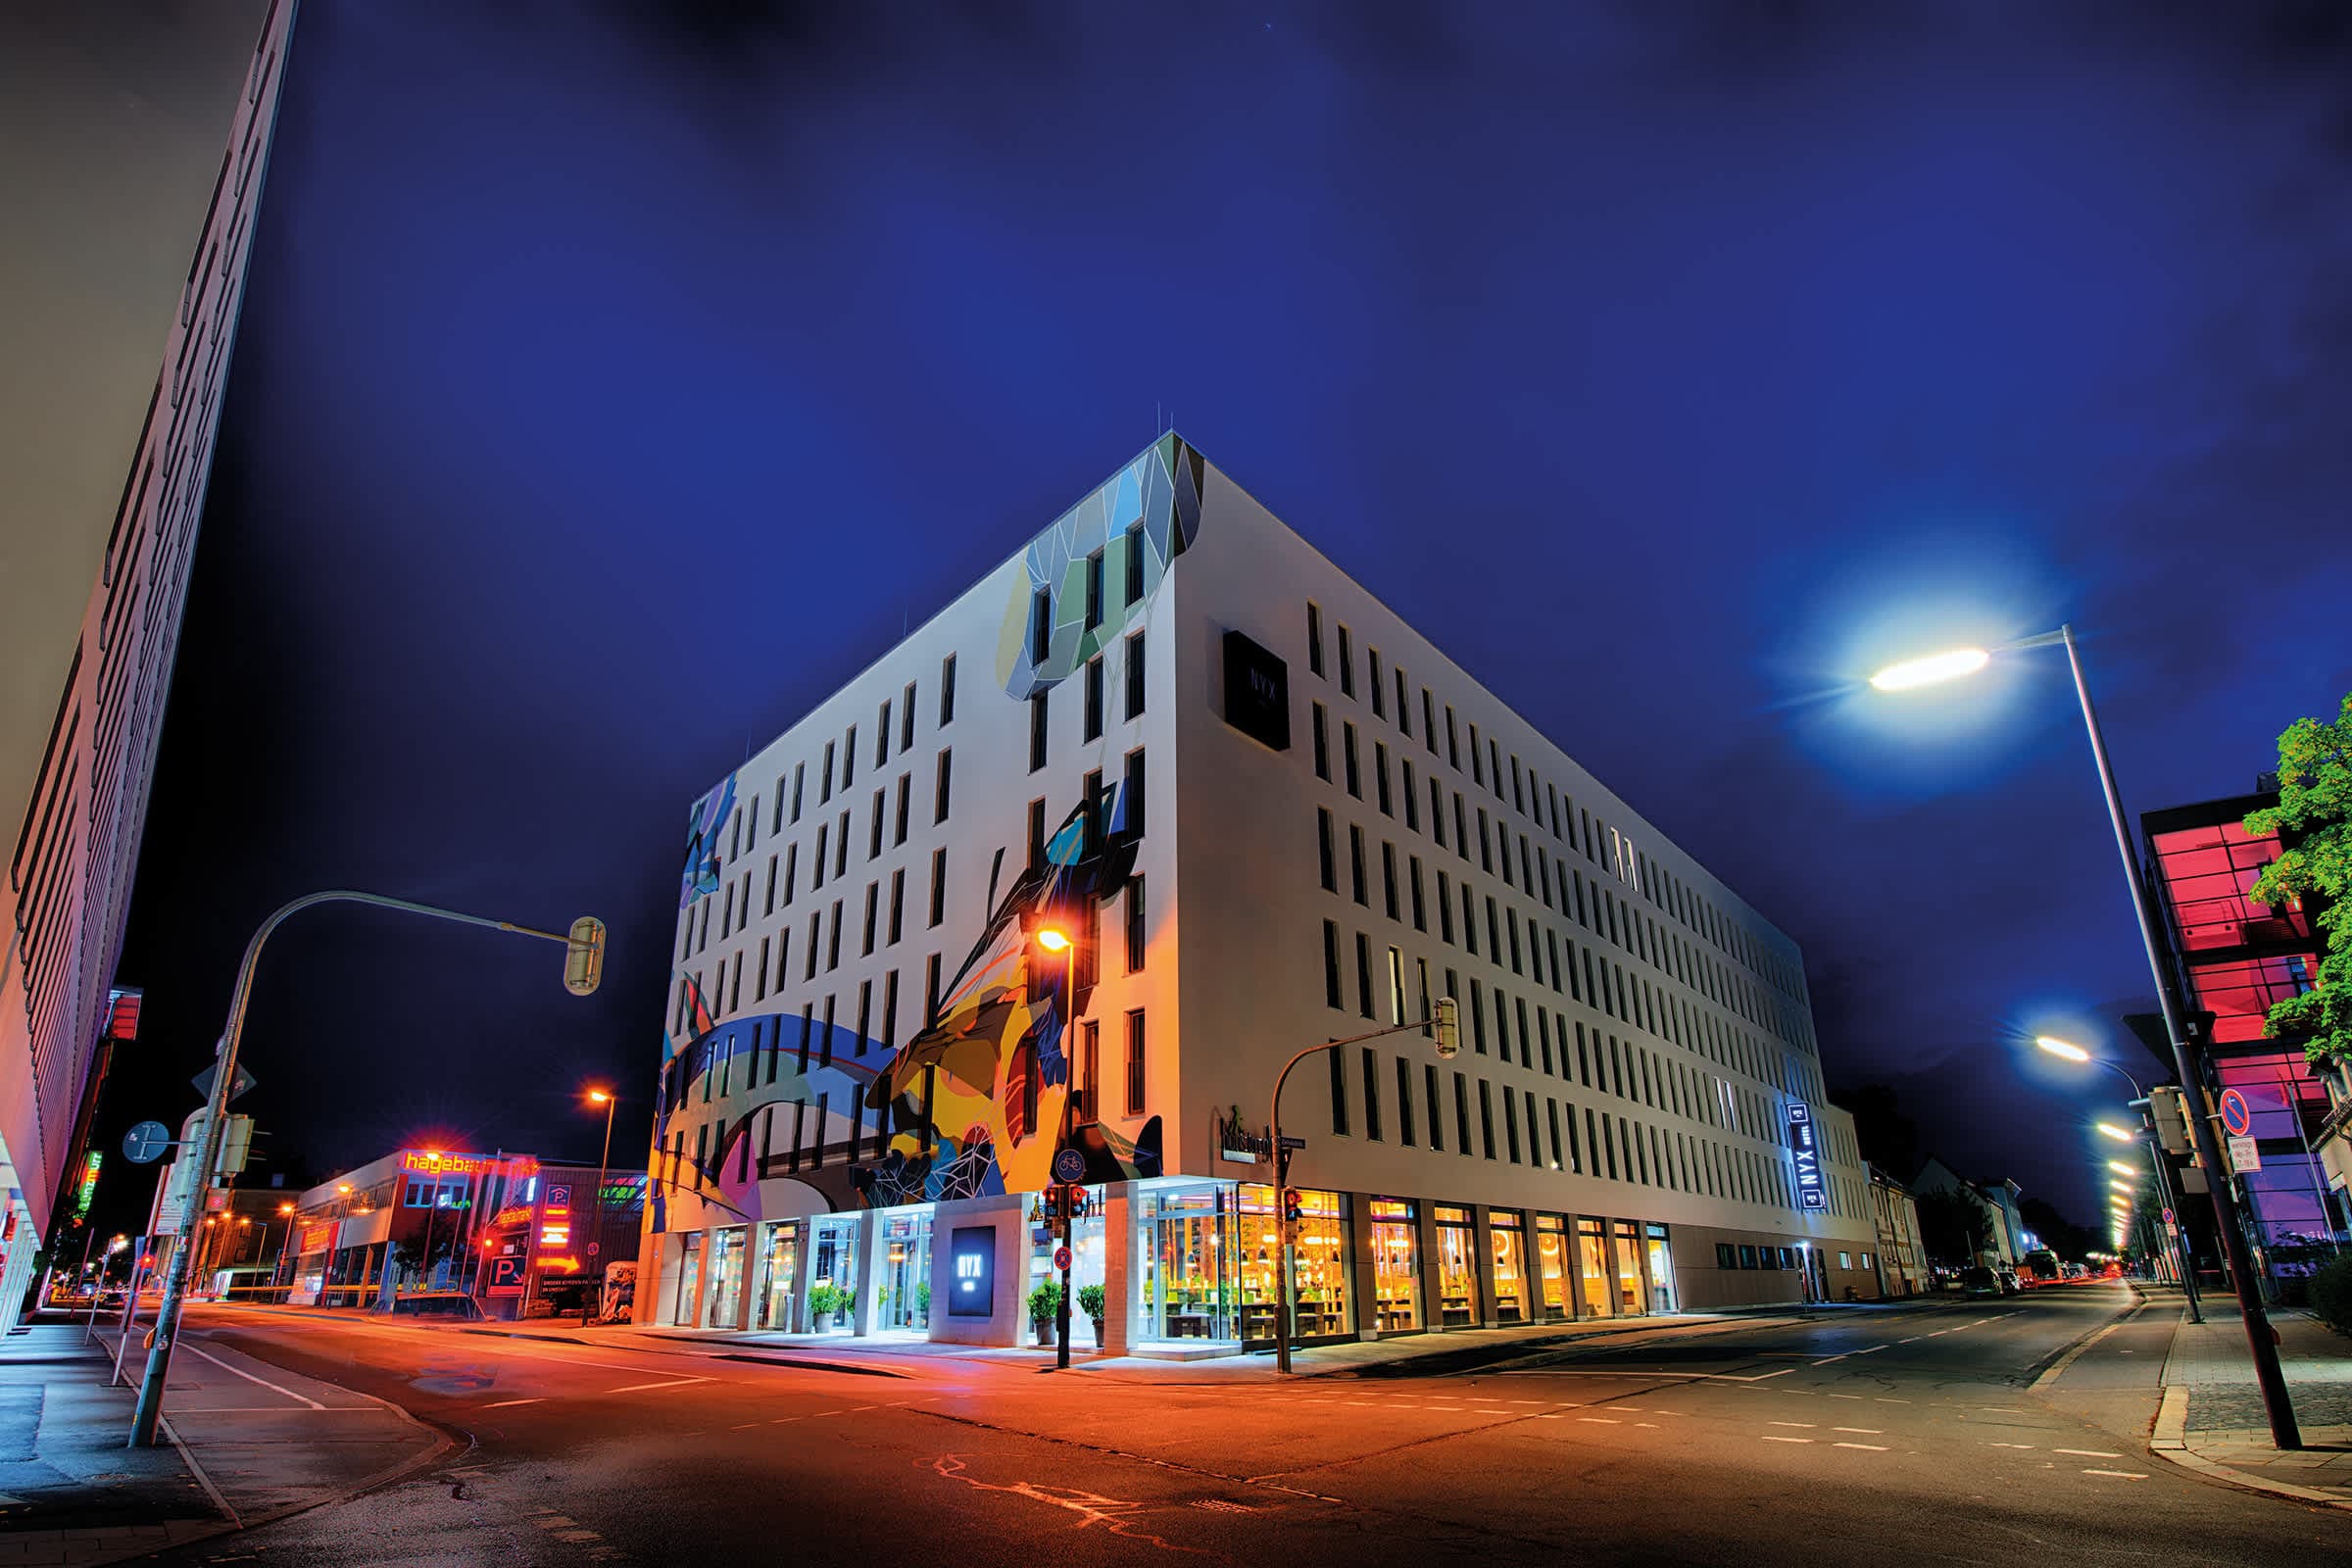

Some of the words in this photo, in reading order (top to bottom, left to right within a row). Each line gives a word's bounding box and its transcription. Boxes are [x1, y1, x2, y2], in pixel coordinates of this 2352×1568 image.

[1250, 667, 1276, 702] NYX
[1796, 1151, 1818, 1185] NYX
[495, 1260, 514, 1284] P
